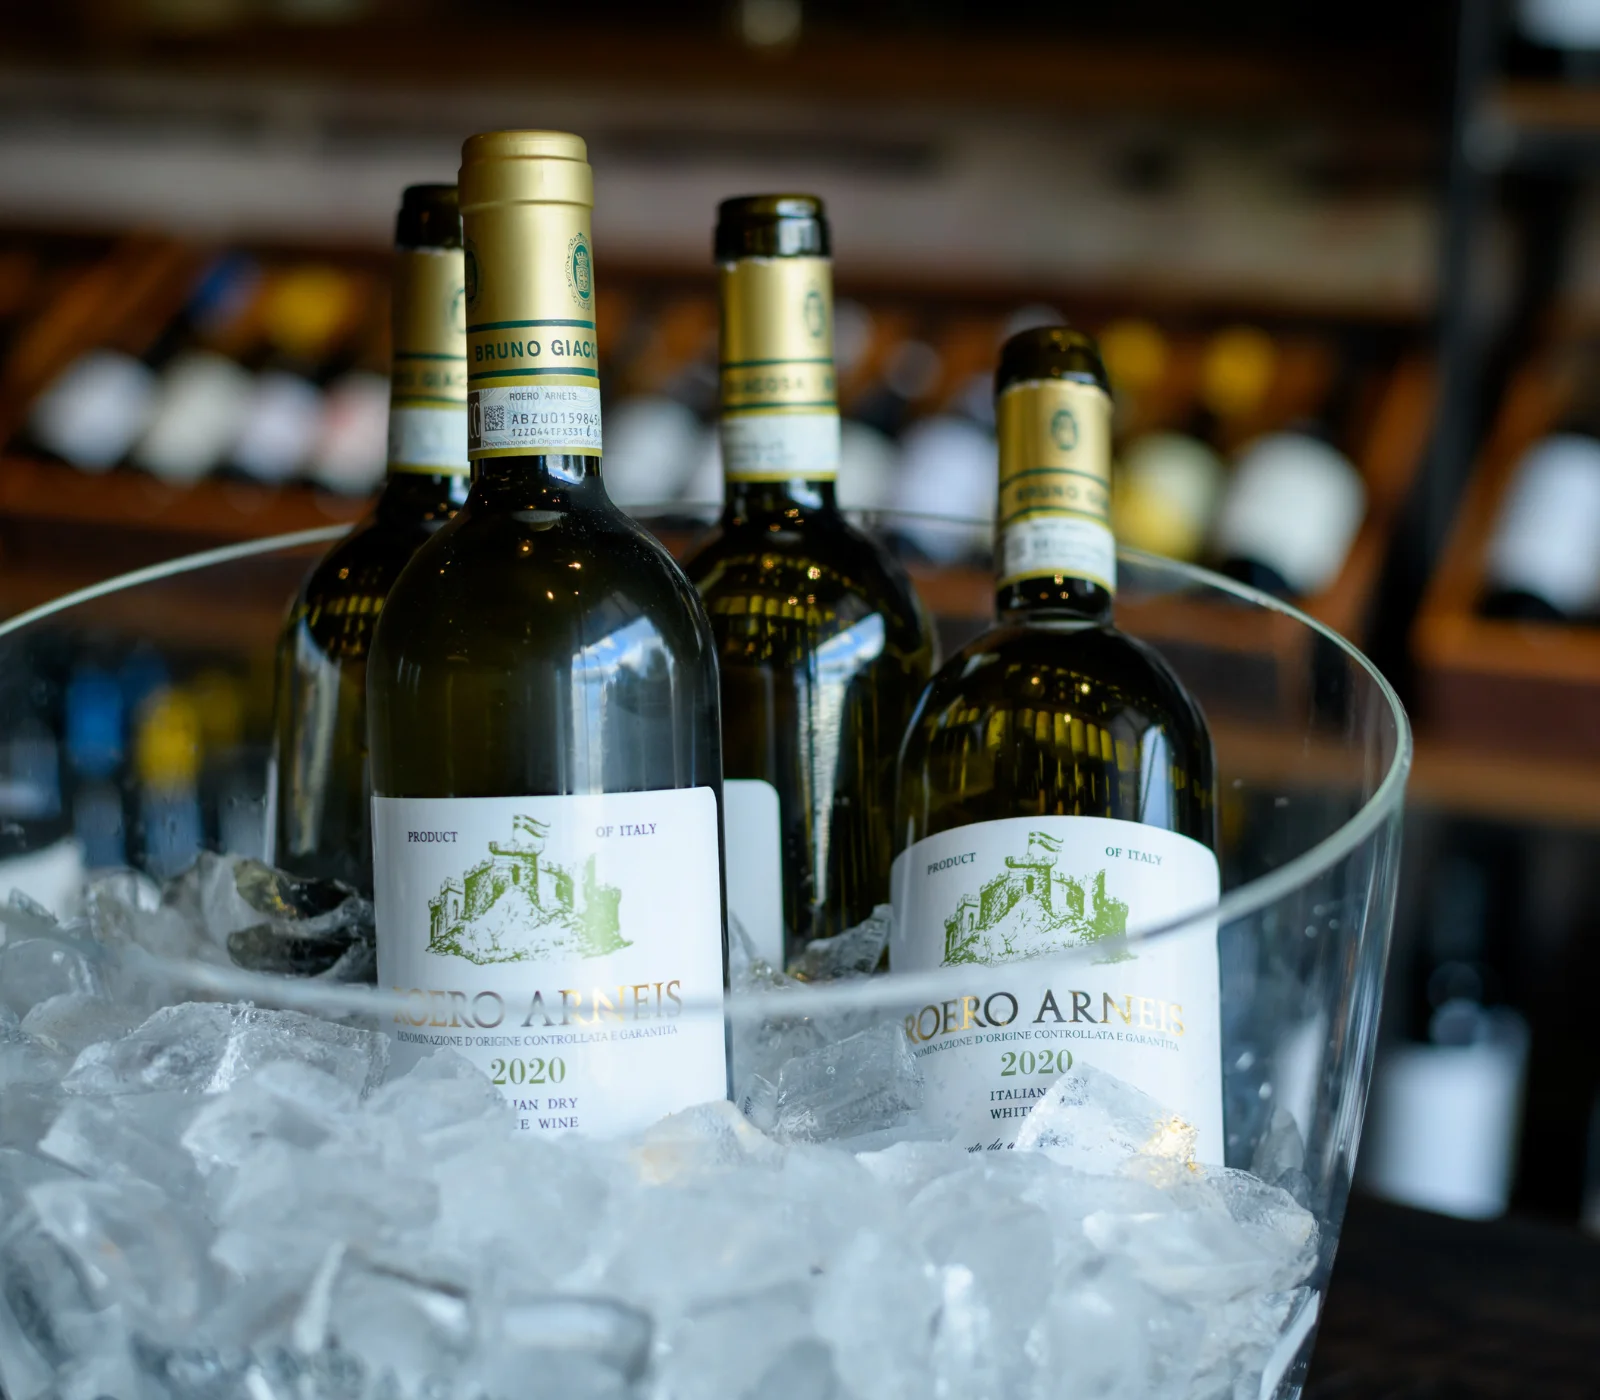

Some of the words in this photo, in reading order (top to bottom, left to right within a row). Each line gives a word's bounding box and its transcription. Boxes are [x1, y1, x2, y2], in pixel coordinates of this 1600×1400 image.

[475, 340, 541, 362] BRUNO
[509, 392, 540, 401] ROERO
[545, 392, 577, 401] ARNEIS
[407, 831, 458, 843] PRODUCT
[595, 826, 614, 838] OF
[619, 823, 657, 836] ITALY
[927, 852, 976, 876] PRODUCT
[1105, 846, 1122, 858] OF
[1127, 849, 1162, 866] ITALY
[520, 980, 683, 1028] ARNEIS
[903, 991, 1019, 1045] ROERO
[1032, 988, 1186, 1037] ARNEIS
[397, 1030, 463, 1047] DENOMINAZIONE
[465, 1036, 521, 1047] D'ORIGINE
[524, 1033, 609, 1046] CONTROLLATA
[611, 1029, 618, 1041] E
[620, 1024, 678, 1040] GARANTITA
[975, 1031, 1032, 1045] D'ORIGINE
[1034, 1029, 1115, 1041] CONTROLLATA
[1116, 1032, 1124, 1041] E
[1125, 1033, 1180, 1052] GARANTITA
[491, 1056, 566, 1085] 2020
[1000, 1048, 1073, 1077] 2020
[547, 1098, 578, 1110] DRY
[990, 1087, 1047, 1102] ITALIAN
[538, 1116, 579, 1130] WINE
